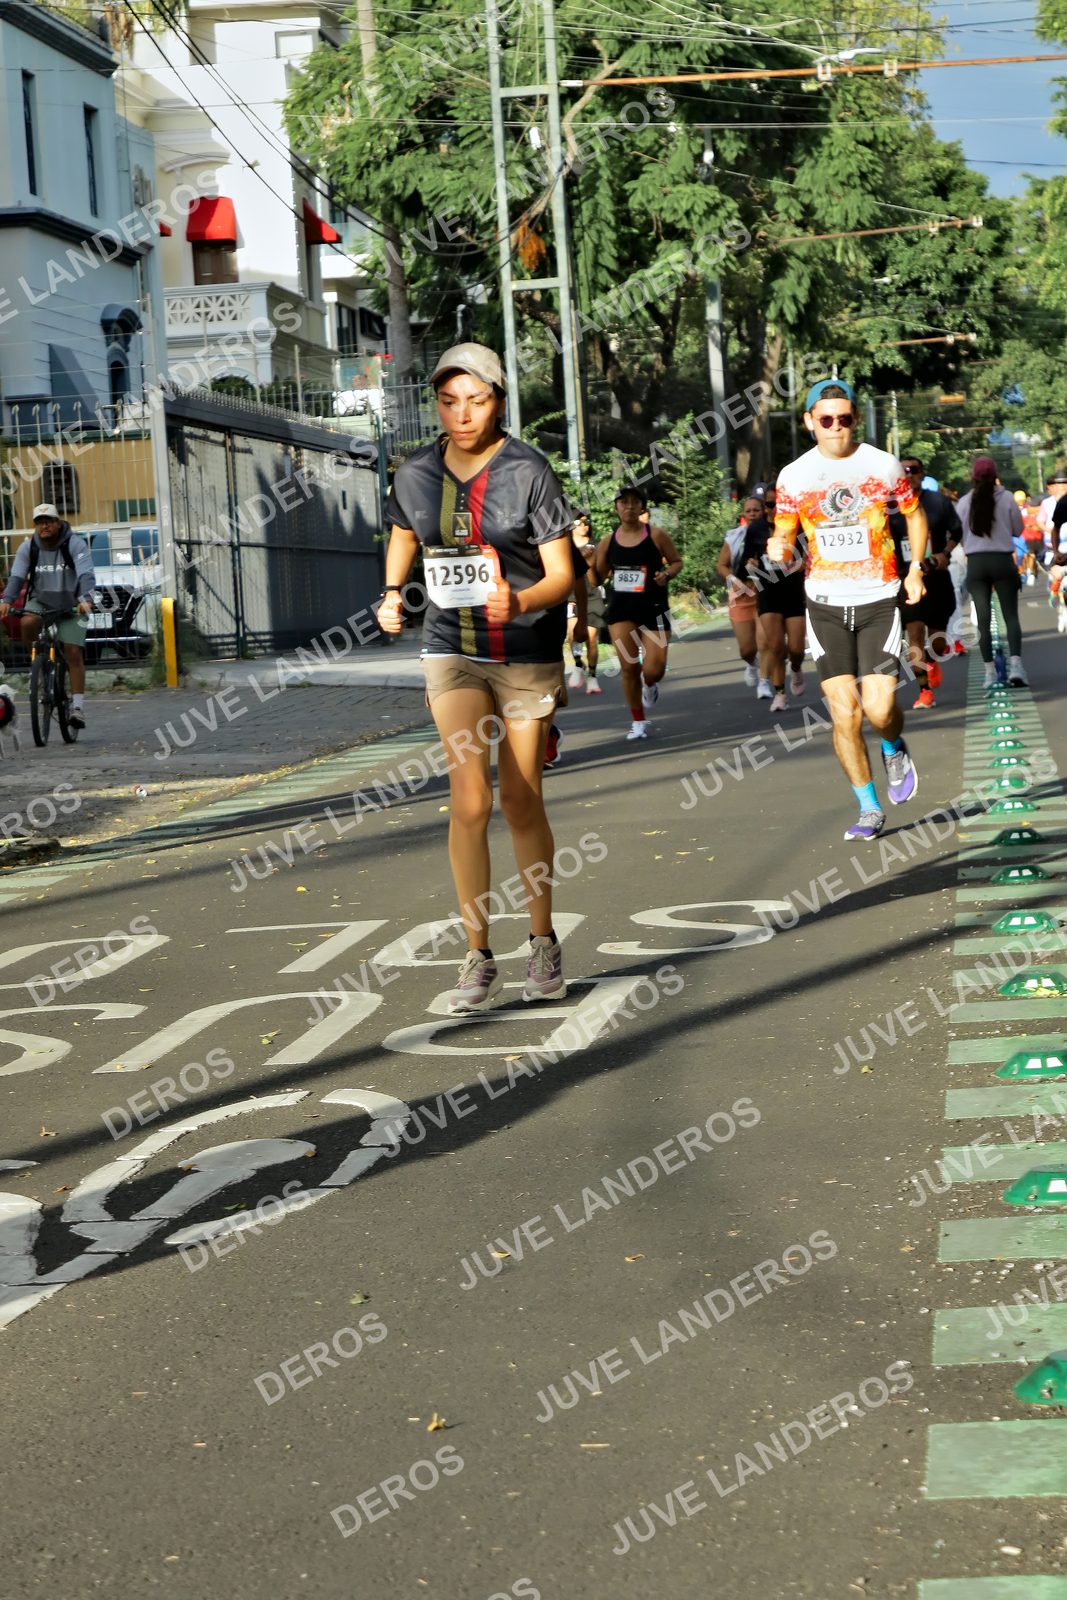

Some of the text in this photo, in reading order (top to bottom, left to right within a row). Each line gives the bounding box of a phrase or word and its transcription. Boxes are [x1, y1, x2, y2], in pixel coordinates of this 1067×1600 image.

[820, 531, 864, 547] 12932
[428, 563, 490, 586] 12596
[618, 573, 639, 583] 9857
